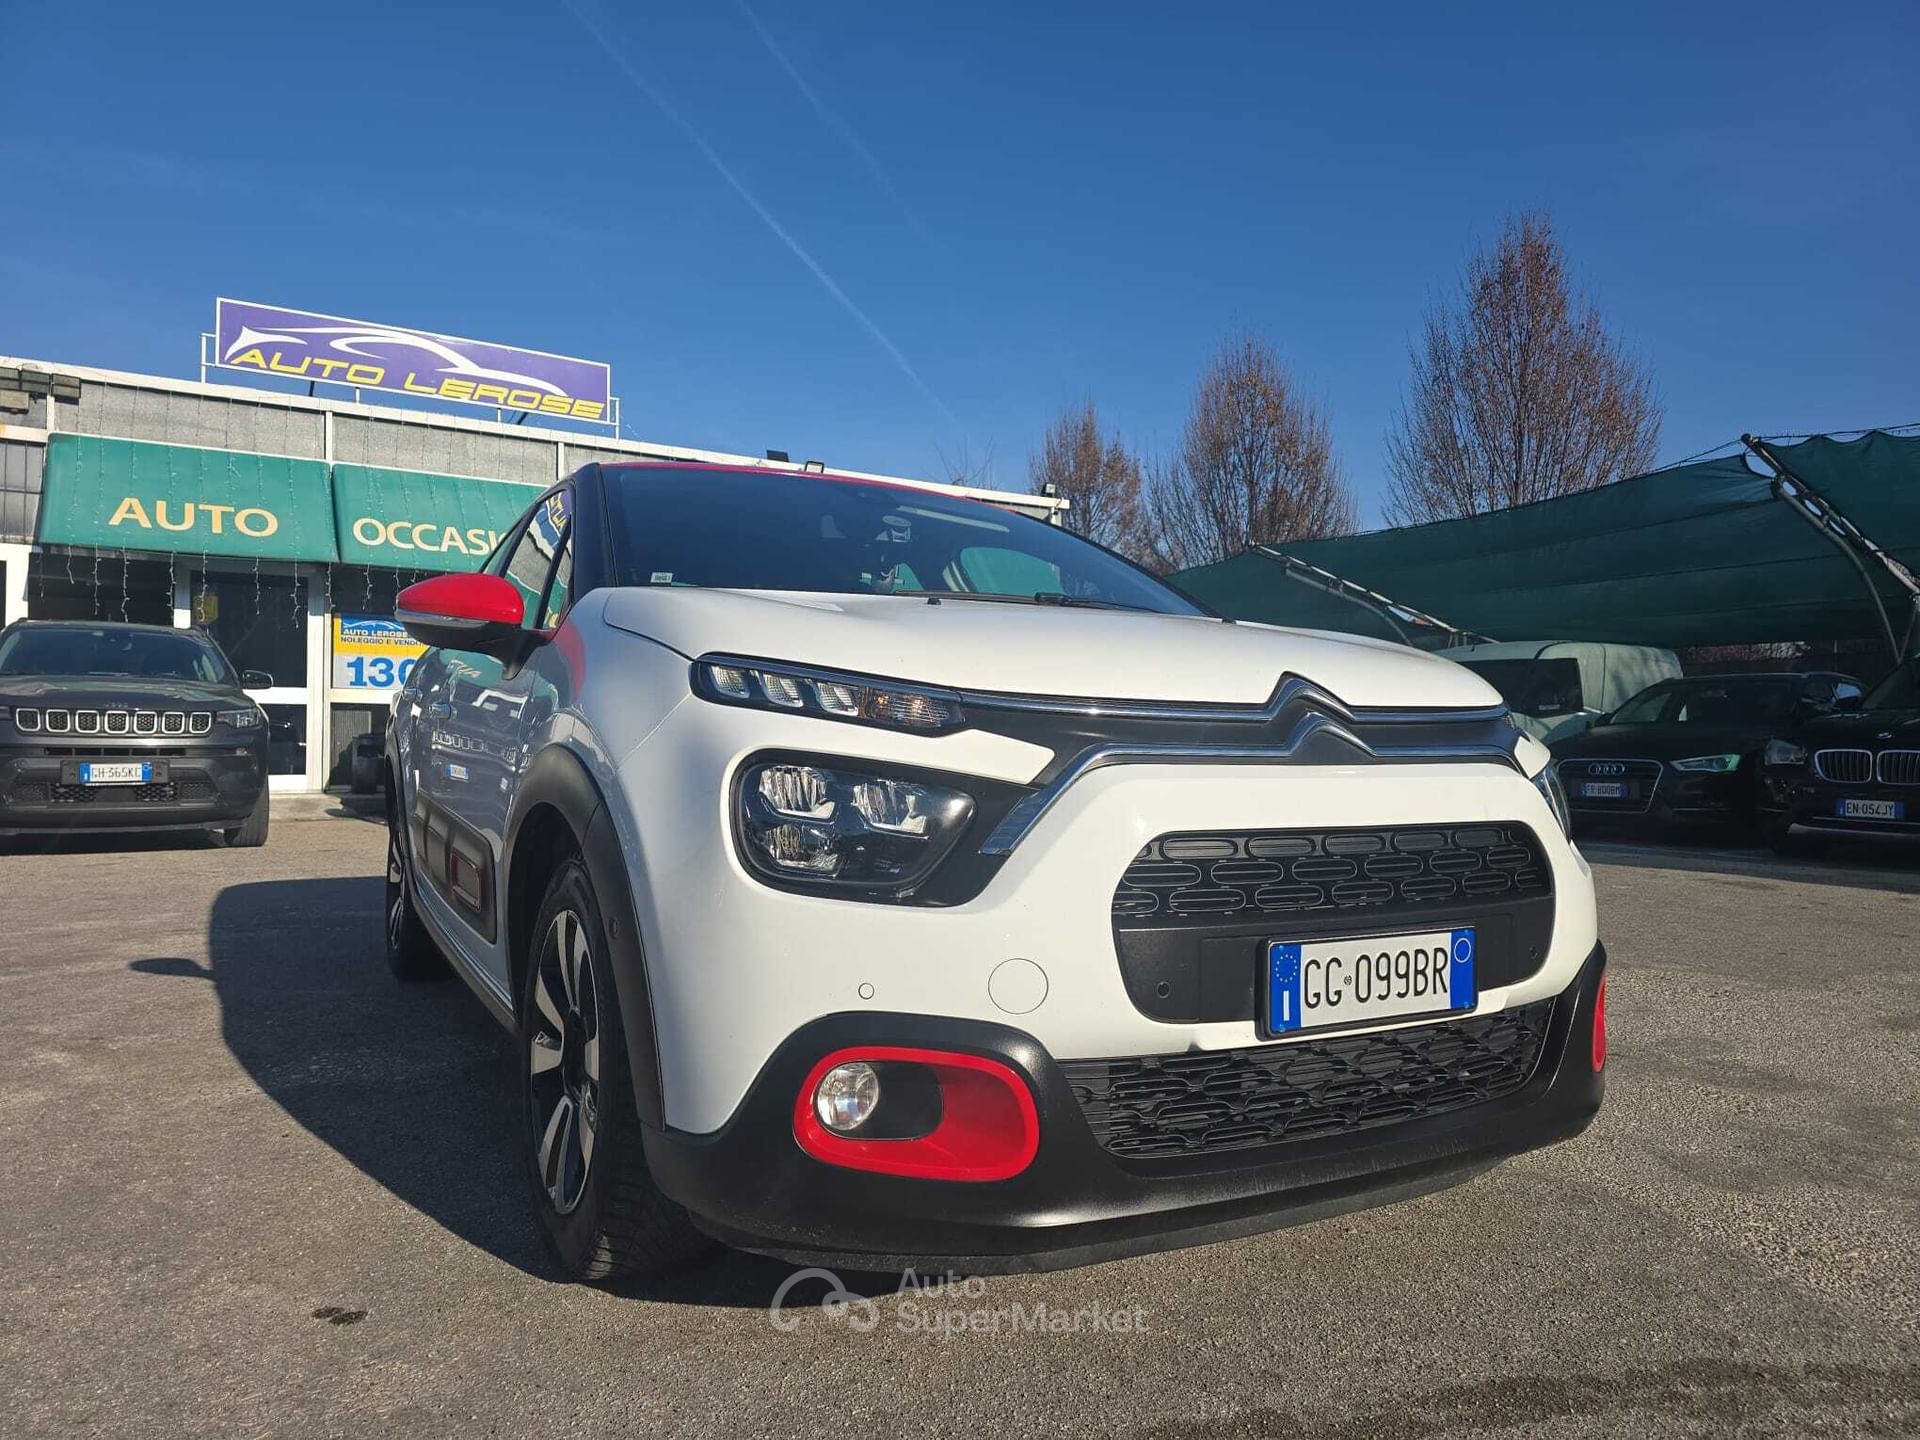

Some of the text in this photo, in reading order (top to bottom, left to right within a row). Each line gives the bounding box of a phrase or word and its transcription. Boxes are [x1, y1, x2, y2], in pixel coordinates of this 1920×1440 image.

[230, 349, 605, 420] AUTO LEROSE
[108, 497, 279, 538] AUTO
[352, 517, 508, 556] OCCASI
[341, 636, 384, 645] NOLEGGIO
[1846, 801, 1859, 814] EN
[1861, 803, 1894, 817] 054JY
[1304, 957, 1343, 1009] GG
[1355, 946, 1448, 1004] 099BR
